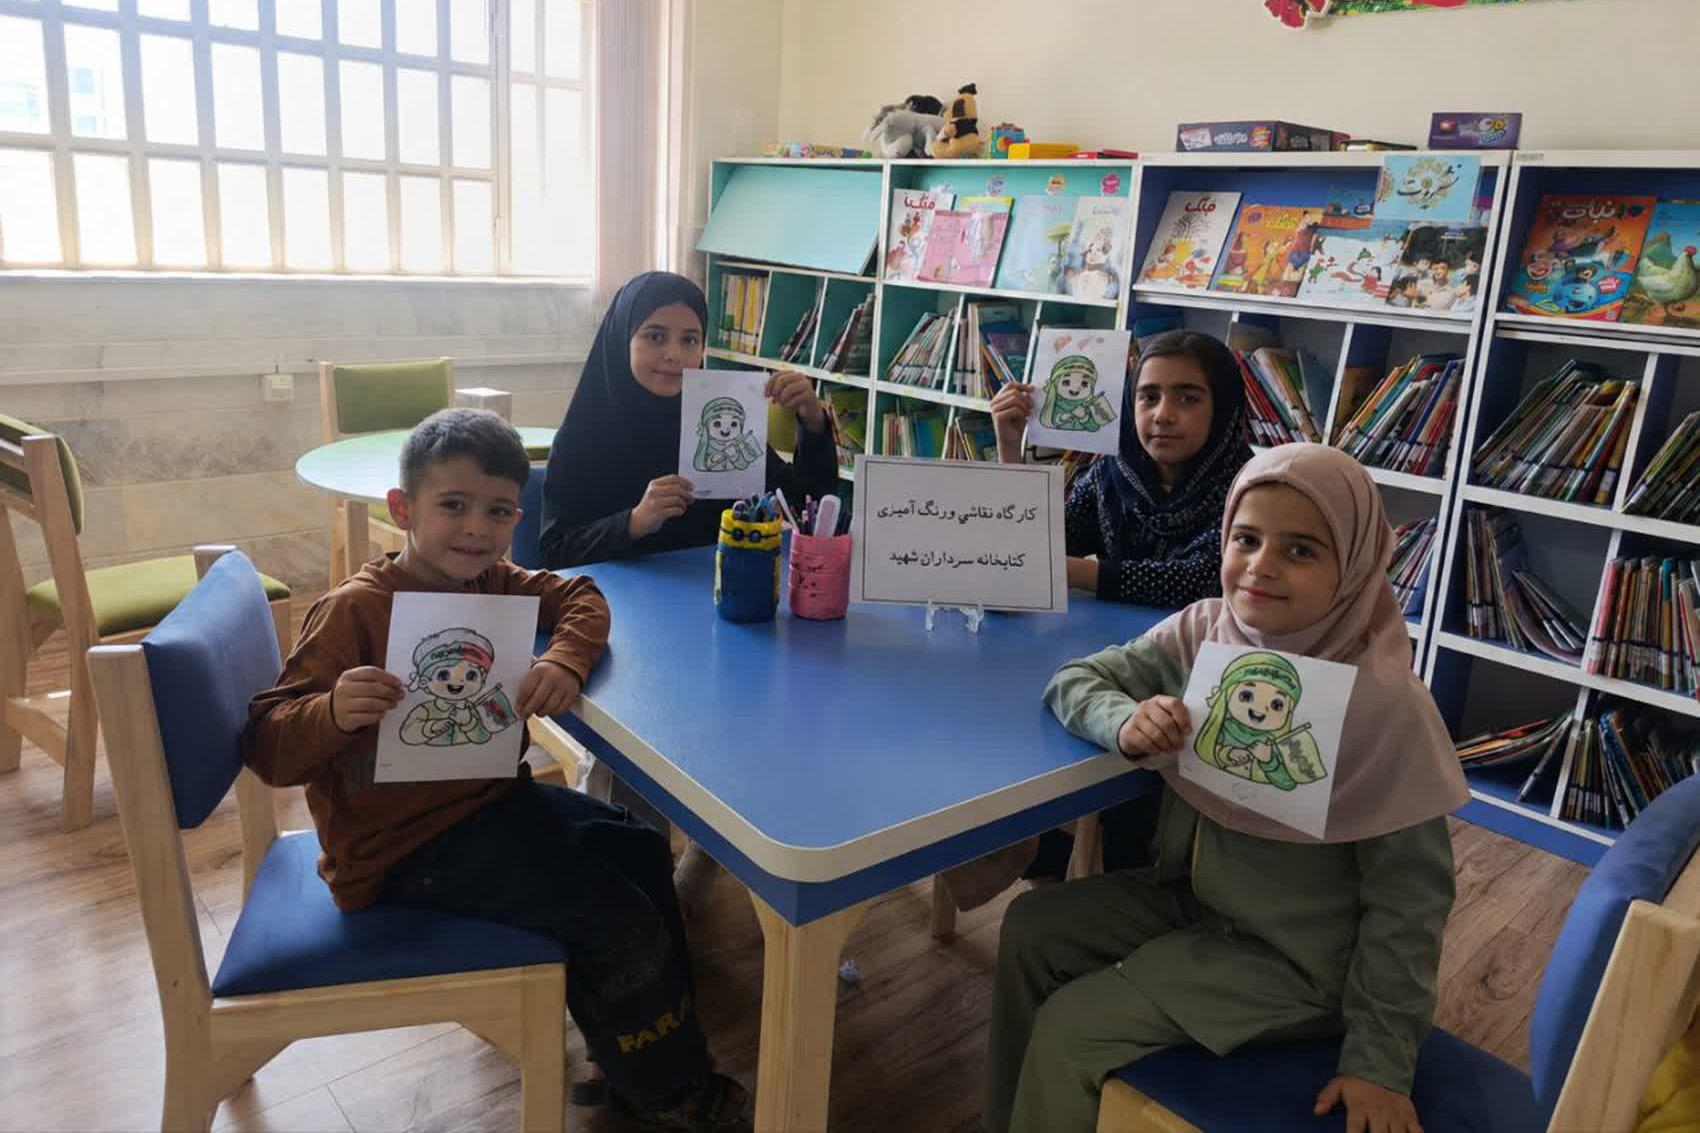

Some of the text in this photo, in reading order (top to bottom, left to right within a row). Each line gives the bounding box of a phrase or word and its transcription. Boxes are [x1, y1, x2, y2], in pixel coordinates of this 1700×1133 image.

[1562, 200, 1616, 224] نبات
[889, 551, 1026, 570] کتابخانه سرداران شهید
